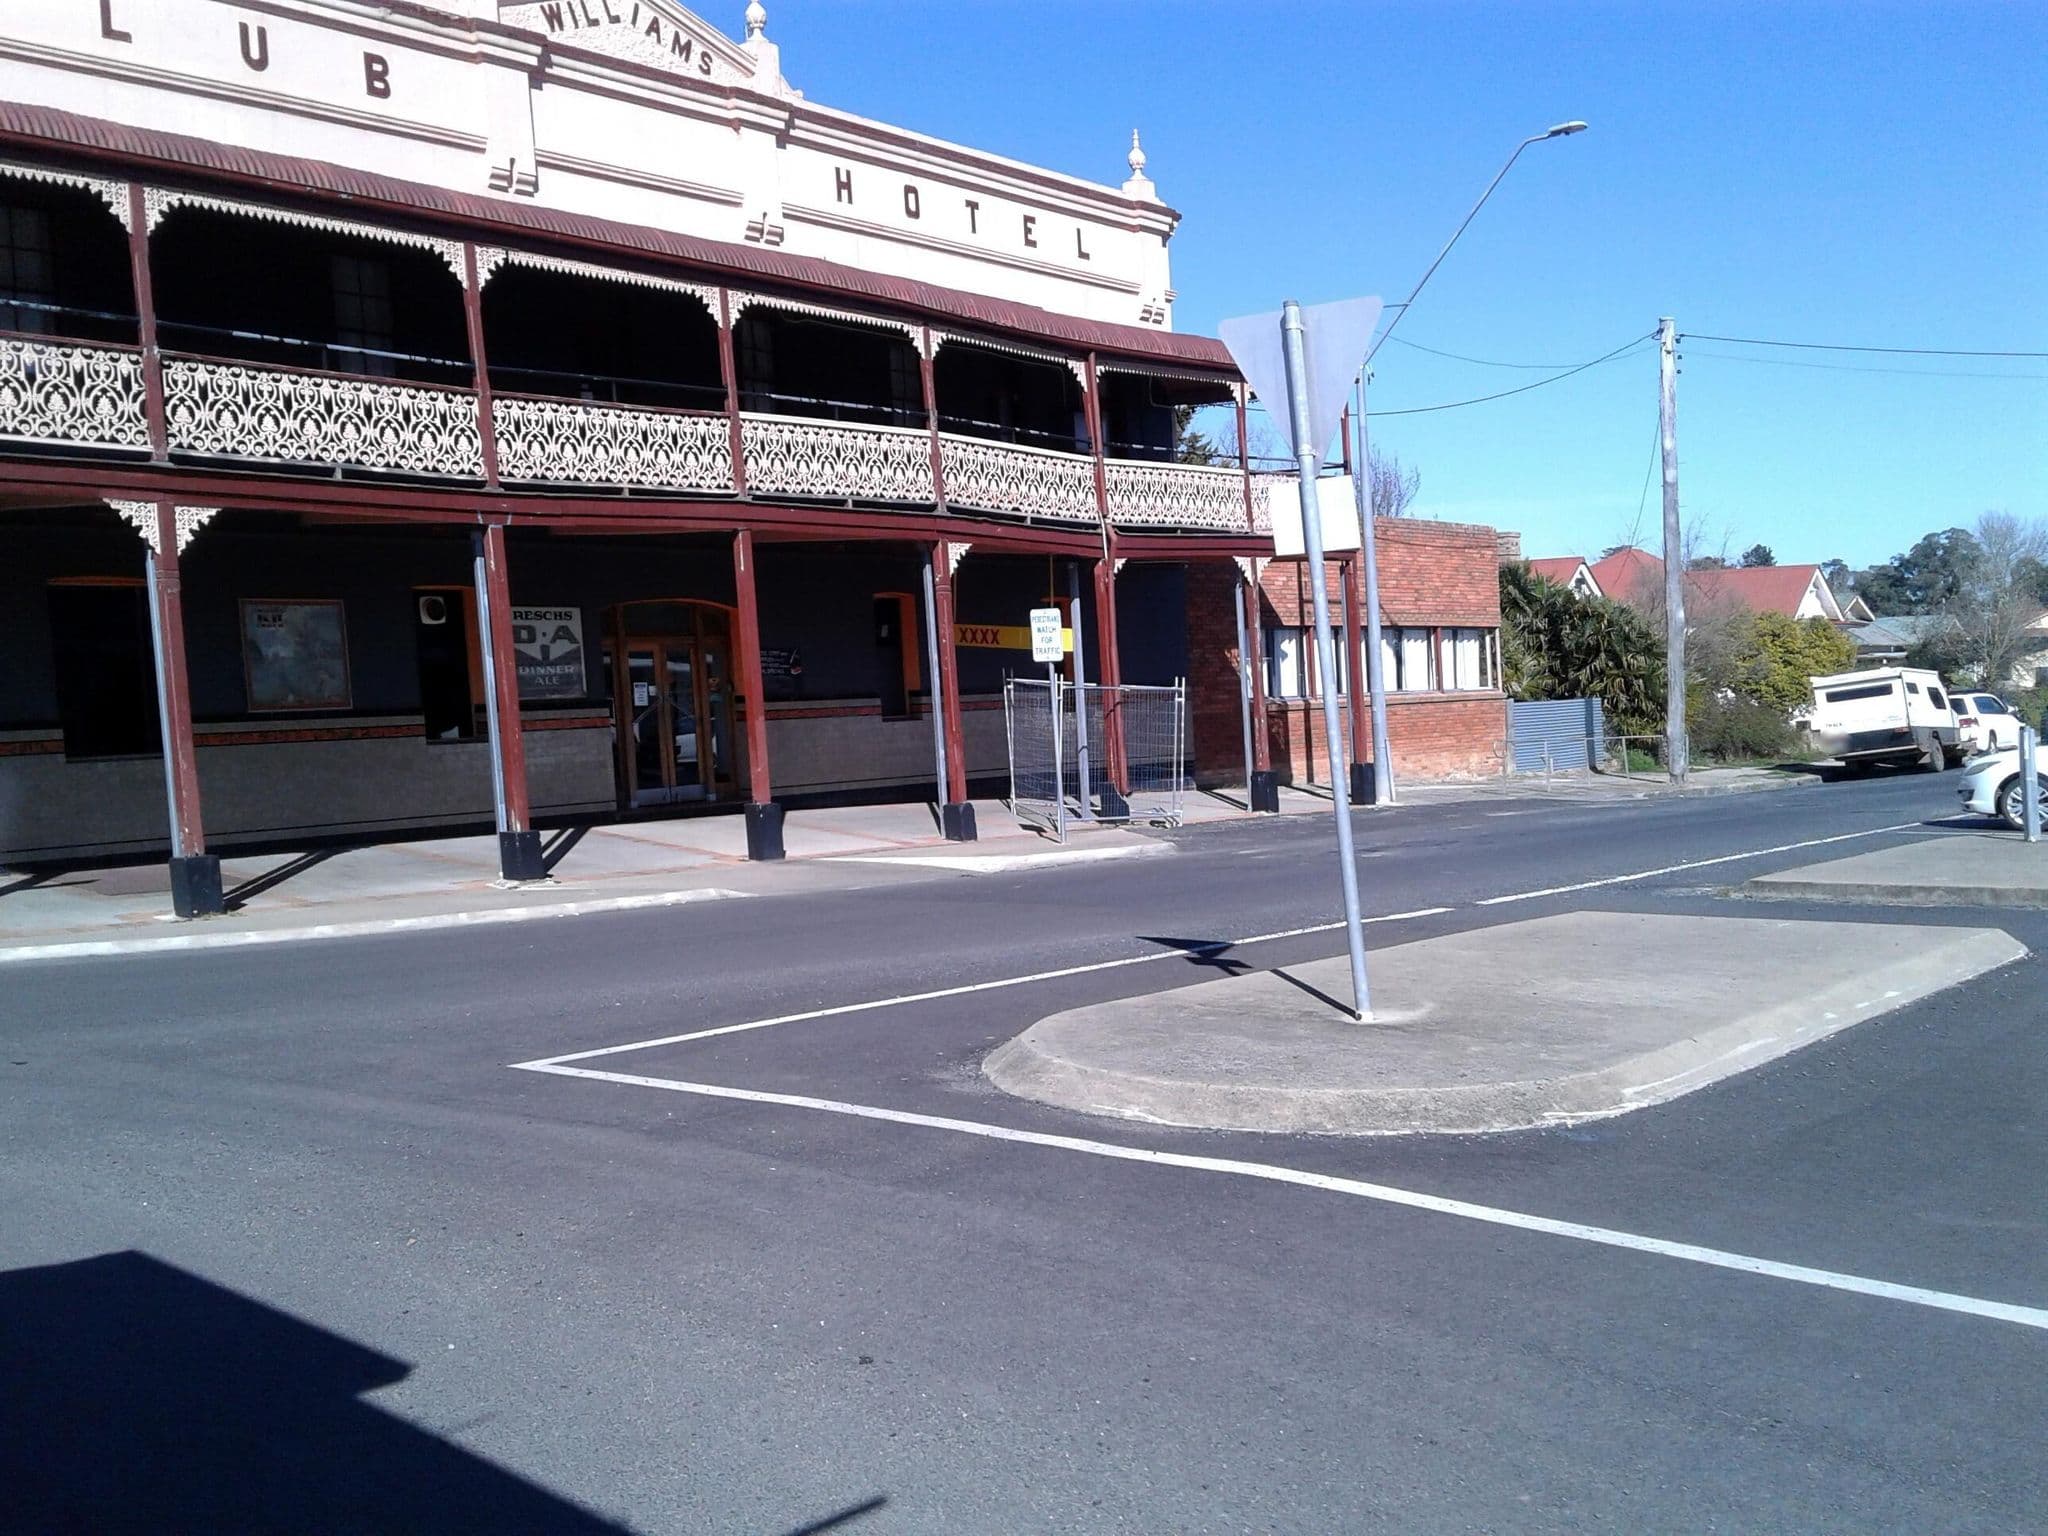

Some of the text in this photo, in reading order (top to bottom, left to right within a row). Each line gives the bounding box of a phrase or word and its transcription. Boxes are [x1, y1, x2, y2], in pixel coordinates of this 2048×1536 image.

[540, 0, 713, 76] WILLIAMS
[835, 166, 1090, 261] HOTEL
[513, 610, 573, 621] RESCHS
[1036, 625, 1057, 634] WATCH
[960, 628, 1000, 645] XXXX
[1041, 636, 1053, 644] FOR
[1035, 647, 1061, 655] TRAFFIC
[519, 665, 575, 675] DINNER
[535, 676, 560, 685] ALE
